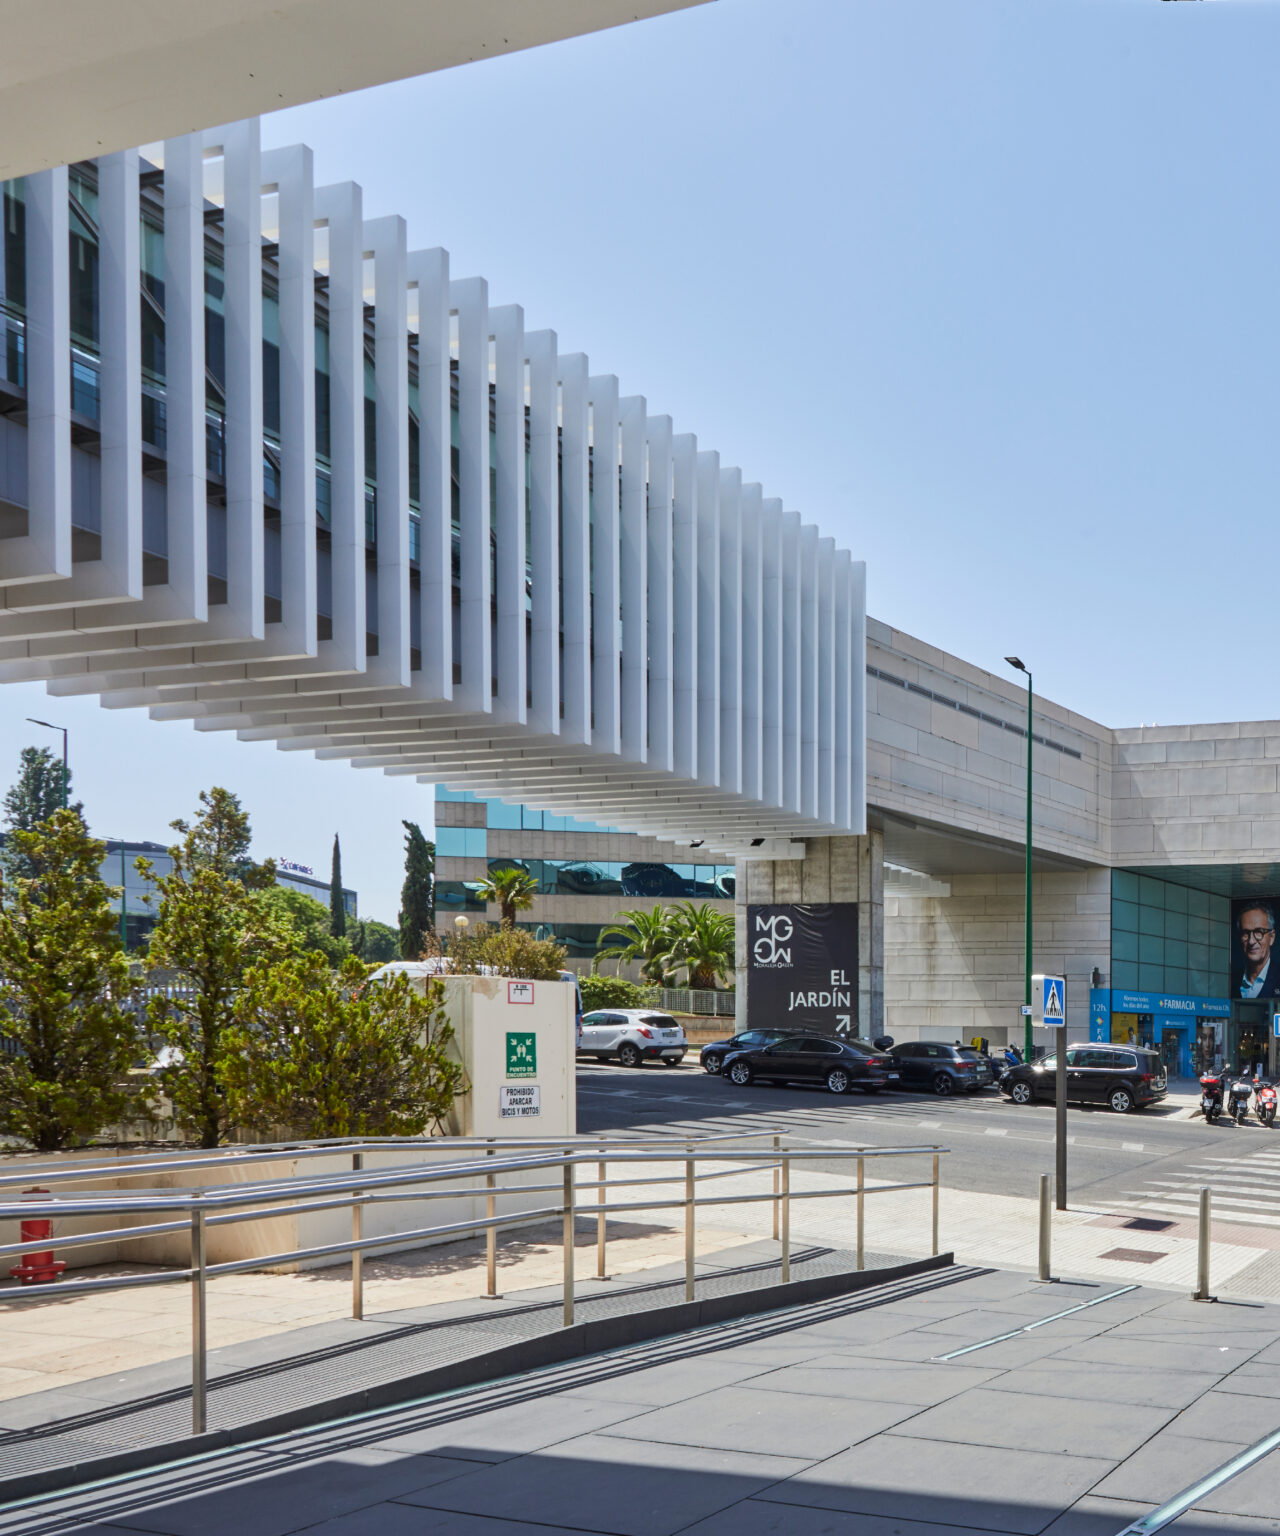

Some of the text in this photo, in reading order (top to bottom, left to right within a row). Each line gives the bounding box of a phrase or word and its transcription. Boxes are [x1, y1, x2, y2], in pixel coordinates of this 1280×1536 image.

[831, 969, 850, 986] EL
[789, 987, 851, 1011] JARDÍN
[1164, 999, 1196, 1010] FARMACIA
[506, 1088, 534, 1096] PROHIBIDO
[509, 1097, 532, 1105] APARCAR
[502, 1108, 516, 1116] BICIS
[521, 1106, 539, 1115] MOTOS
